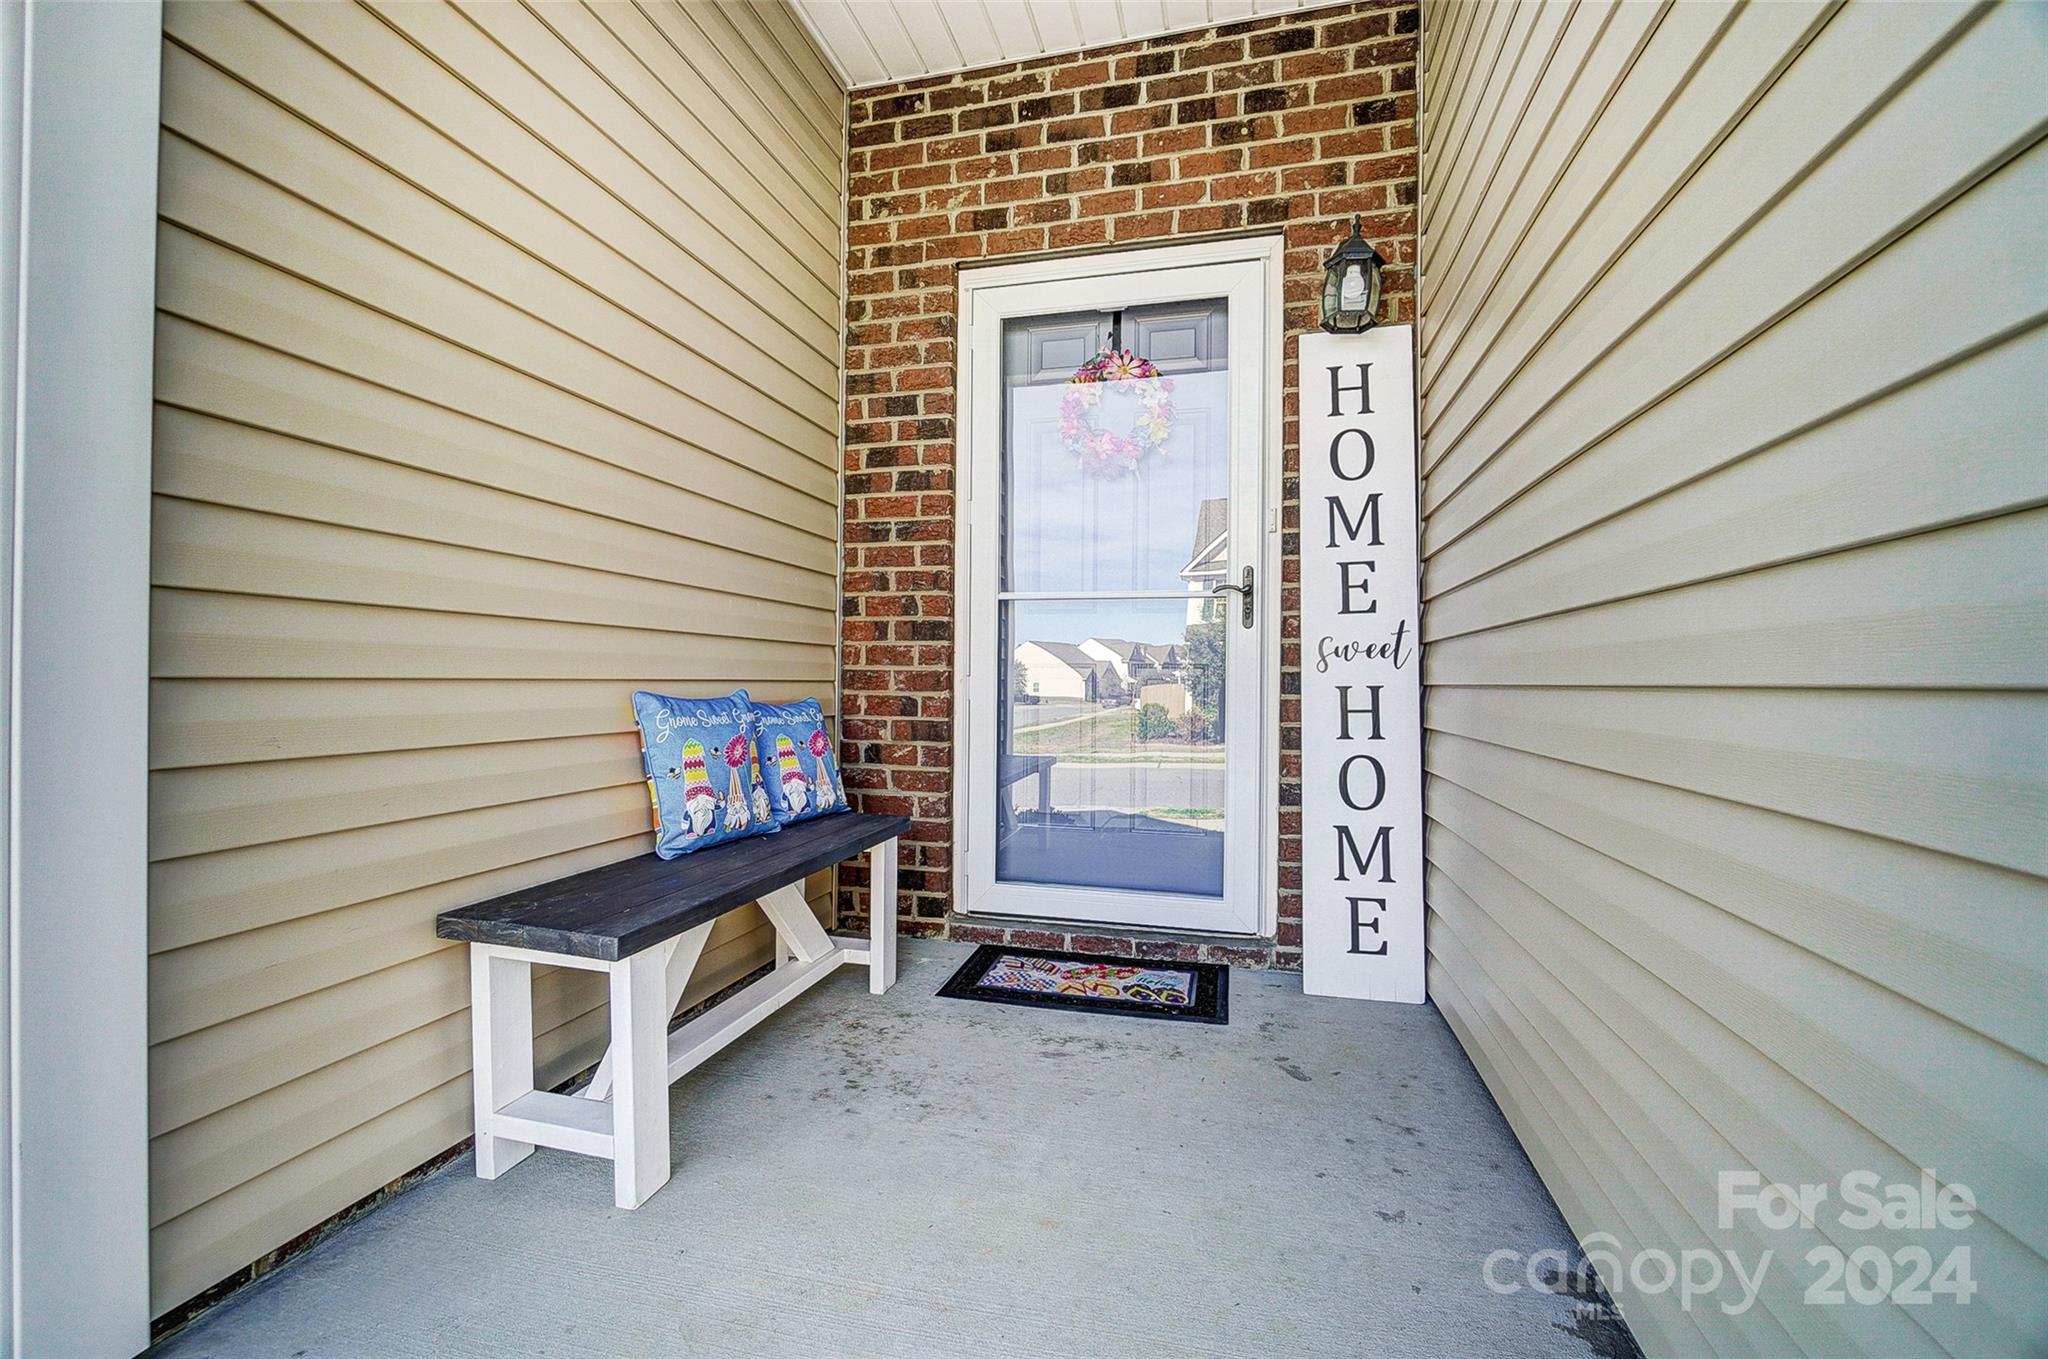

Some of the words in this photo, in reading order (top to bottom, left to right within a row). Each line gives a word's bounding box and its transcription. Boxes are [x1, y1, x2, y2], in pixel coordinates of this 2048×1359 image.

[1324, 362, 1385, 615] HOME
[1315, 619, 1412, 673] sweet
[655, 709, 699, 743] Gnome
[697, 710, 732, 728] Sweet
[1332, 685, 1396, 956] HOME
